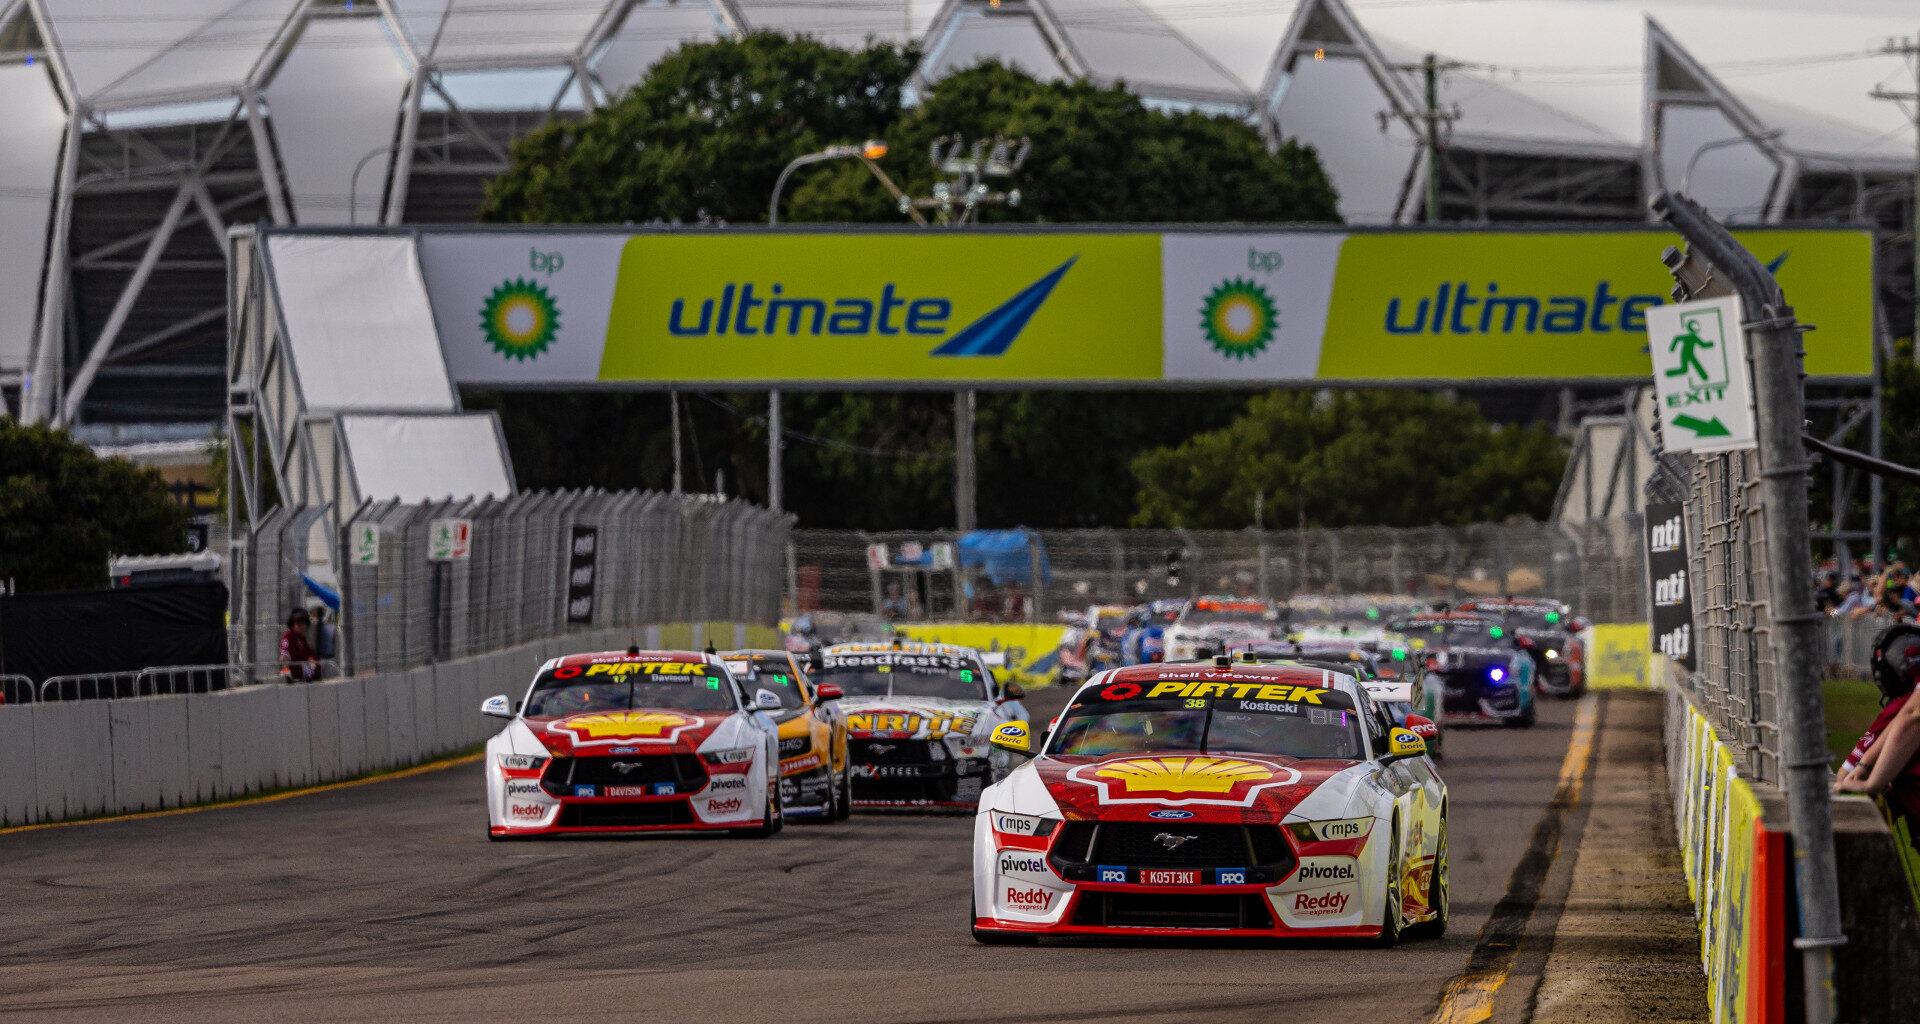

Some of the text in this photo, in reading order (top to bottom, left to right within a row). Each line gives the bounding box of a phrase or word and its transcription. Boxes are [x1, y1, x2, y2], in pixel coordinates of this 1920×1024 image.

[530, 247, 564, 278] bp
[1248, 245, 1282, 276] bp
[667, 283, 953, 337] ultimate
[1383, 281, 1665, 336] ultimate
[1667, 388, 1723, 408] EXIT
[1652, 515, 1681, 547] nti
[1655, 569, 1685, 601] nti
[1660, 623, 1690, 655] nti
[585, 662, 708, 676] PIRTEK
[823, 655, 940, 668] Steadfast
[774, 674, 788, 686] 4
[1204, 673, 1279, 681] V-Power
[1146, 682, 1330, 705] PIRTEK
[1184, 699, 1206, 709] 38
[1240, 700, 1298, 714] Kostecki
[847, 713, 976, 735] NRITE
[996, 734, 1022, 745] Doric
[1401, 742, 1424, 750] Doric
[510, 757, 528, 766] mps
[881, 767, 921, 775] STEEL
[508, 782, 541, 796] pivotel.
[512, 804, 546, 819] Reddy
[707, 797, 742, 812] Reddy
[1006, 818, 1031, 832] mps
[1332, 822, 1359, 837] mps
[1001, 855, 1047, 874] pivotel.
[1299, 862, 1354, 882] pivotel.
[1103, 871, 1126, 882] PPQ
[1222, 873, 1245, 884] PPQ
[1007, 888, 1053, 910] Reddy
[1294, 891, 1350, 913] Reddy
[1309, 908, 1339, 917] express
